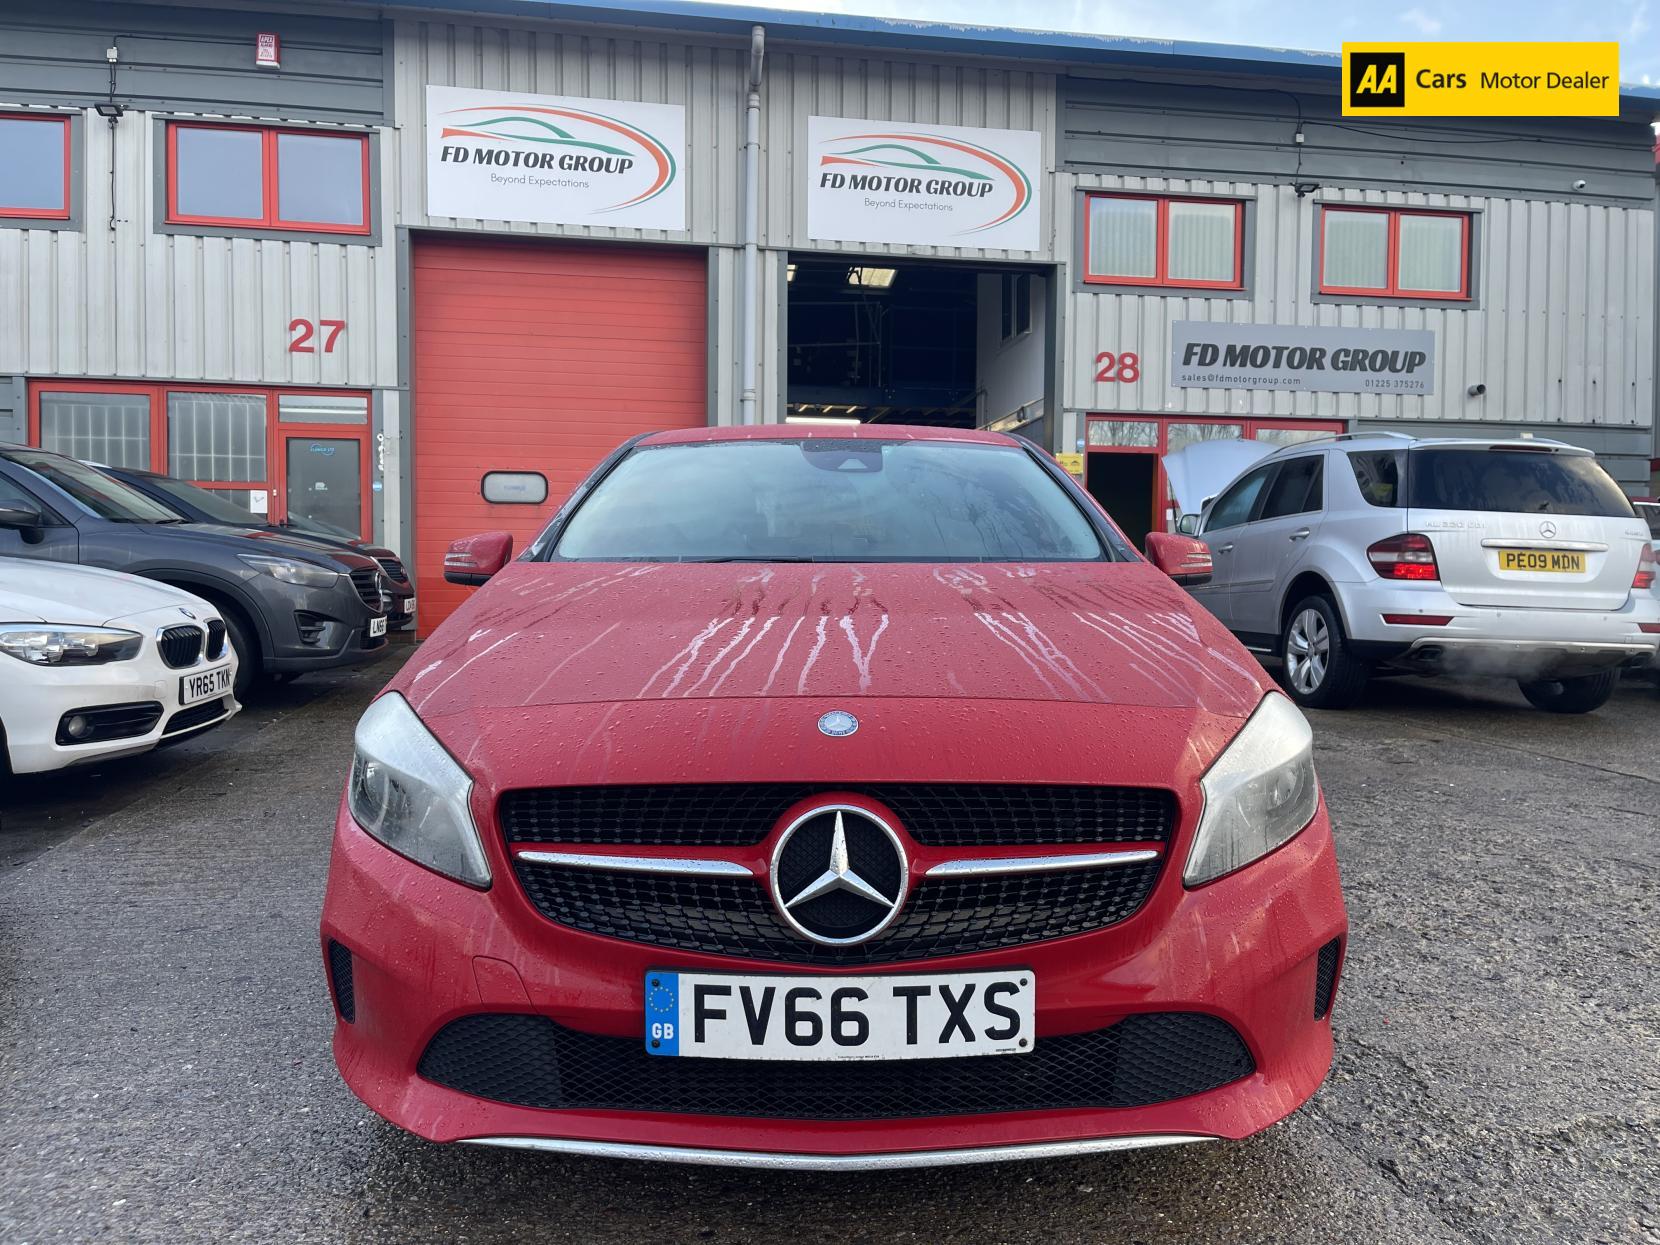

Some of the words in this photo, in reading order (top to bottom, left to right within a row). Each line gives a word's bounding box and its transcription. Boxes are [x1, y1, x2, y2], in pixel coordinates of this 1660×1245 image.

[440, 145, 469, 163] FD
[473, 148, 554, 169] MOTOR
[558, 154, 633, 174] GROUP
[490, 173, 526, 185] Beyond
[528, 175, 590, 188] Expectations
[820, 172, 845, 189] FD
[848, 174, 921, 194] MOTOR
[925, 179, 993, 198] GROUP
[864, 197, 896, 208] Beyond
[898, 199, 953, 212] Expectations
[288, 318, 346, 353] 27
[1093, 351, 1140, 384] 28
[1182, 342, 1219, 367] FD
[1222, 344, 1326, 371] MOTOR
[1330, 347, 1426, 374] GROUP
[1181, 373, 1301, 385] sales@fdmotorgroup.com
[1365, 379, 1391, 388] 01225
[1393, 380, 1425, 389] 375276
[1506, 552, 1547, 569] PE09
[1551, 554, 1580, 570] MDN
[189, 673, 215, 698] YR65
[693, 983, 870, 1047] FV66
[892, 981, 1021, 1045] TXS
[652, 1022, 674, 1040] GB
